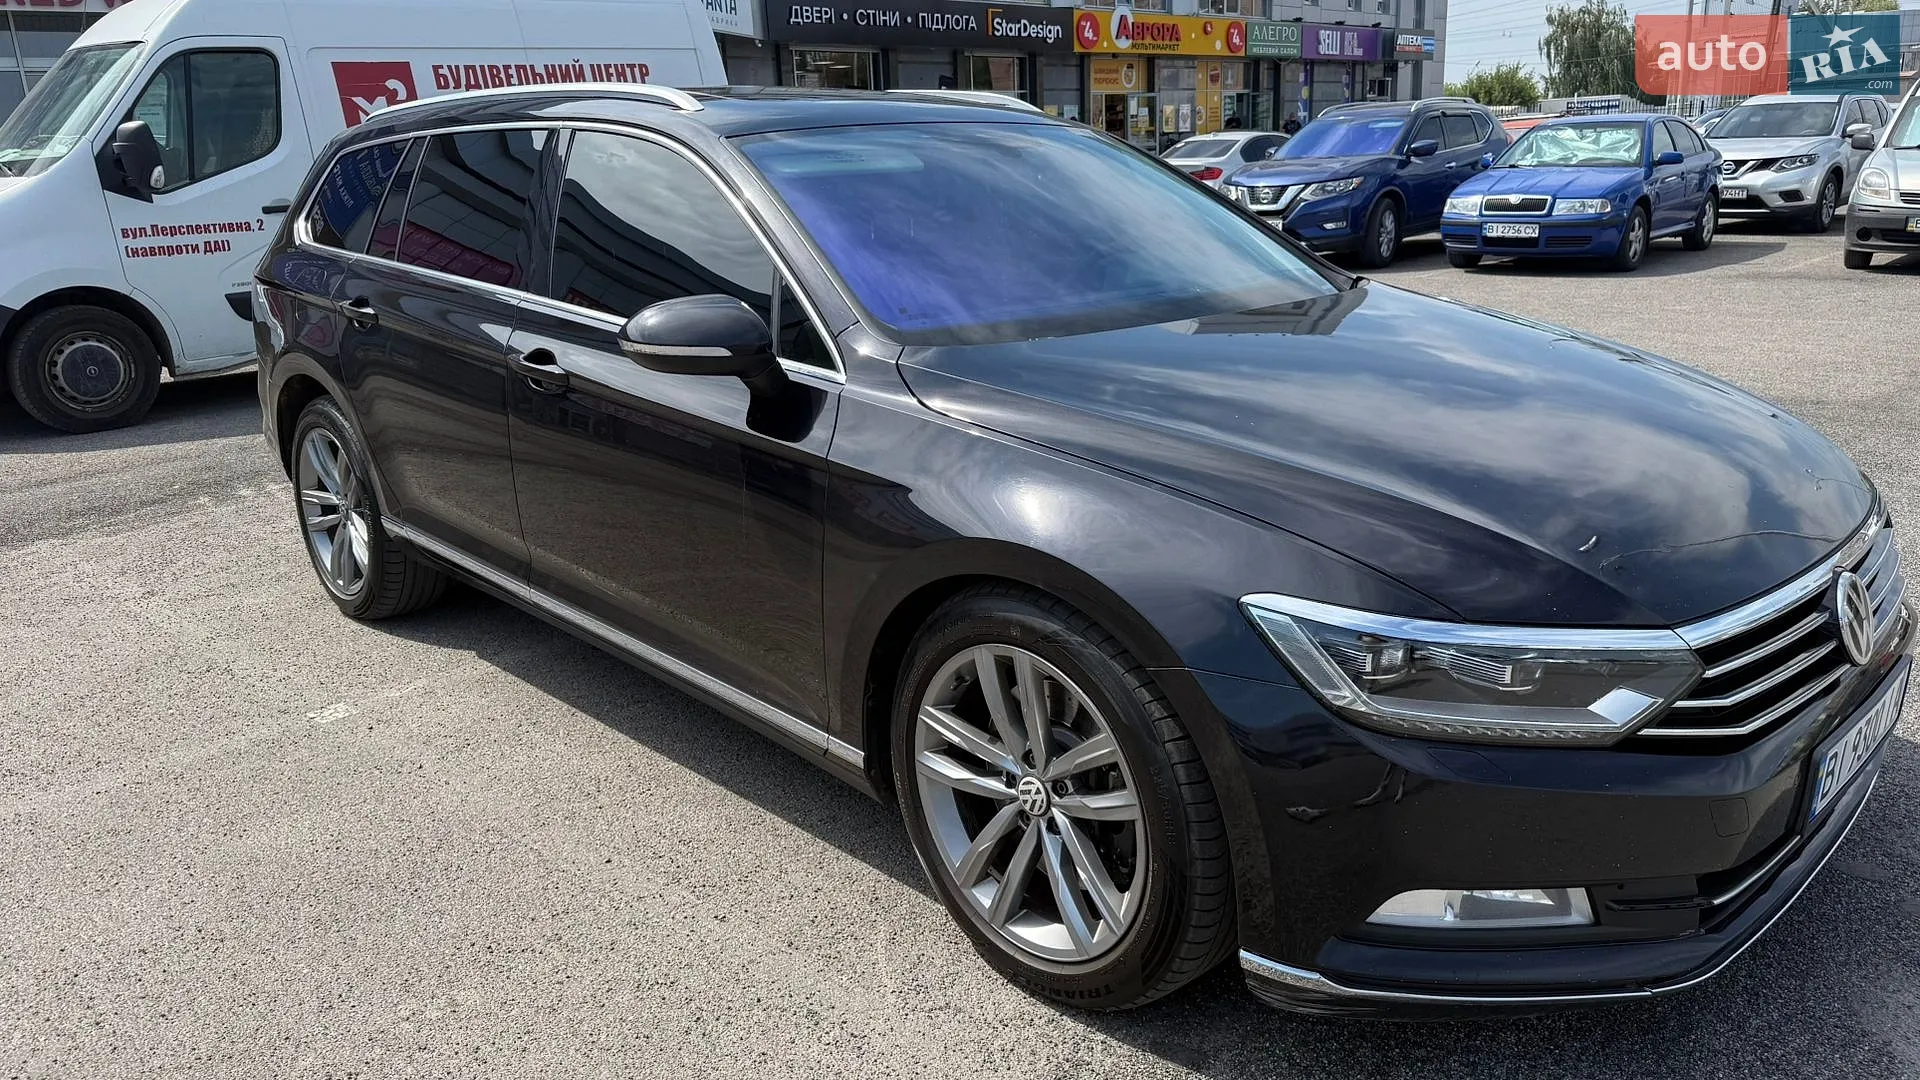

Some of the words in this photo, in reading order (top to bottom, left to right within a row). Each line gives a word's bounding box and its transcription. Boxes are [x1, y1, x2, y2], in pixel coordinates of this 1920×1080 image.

[790, 5, 835, 25] ДВЕРІ
[856, 9, 900, 27] СТІНИ
[918, 12, 977, 32] ПІДЛОГА
[993, 17, 1062, 43] StarDesign
[1115, 14, 1181, 42] АВРОРА
[1252, 25, 1297, 41] АЛЕГРО
[1131, 42, 1180, 51] МУЛЬТИМАРКЕТ
[1318, 29, 1340, 55] SELLI
[256, 218, 265, 231] 2
[1501, 225, 1522, 235] 2756
[1524, 225, 1537, 235] CX
[124, 243, 199, 259] (навпроти
